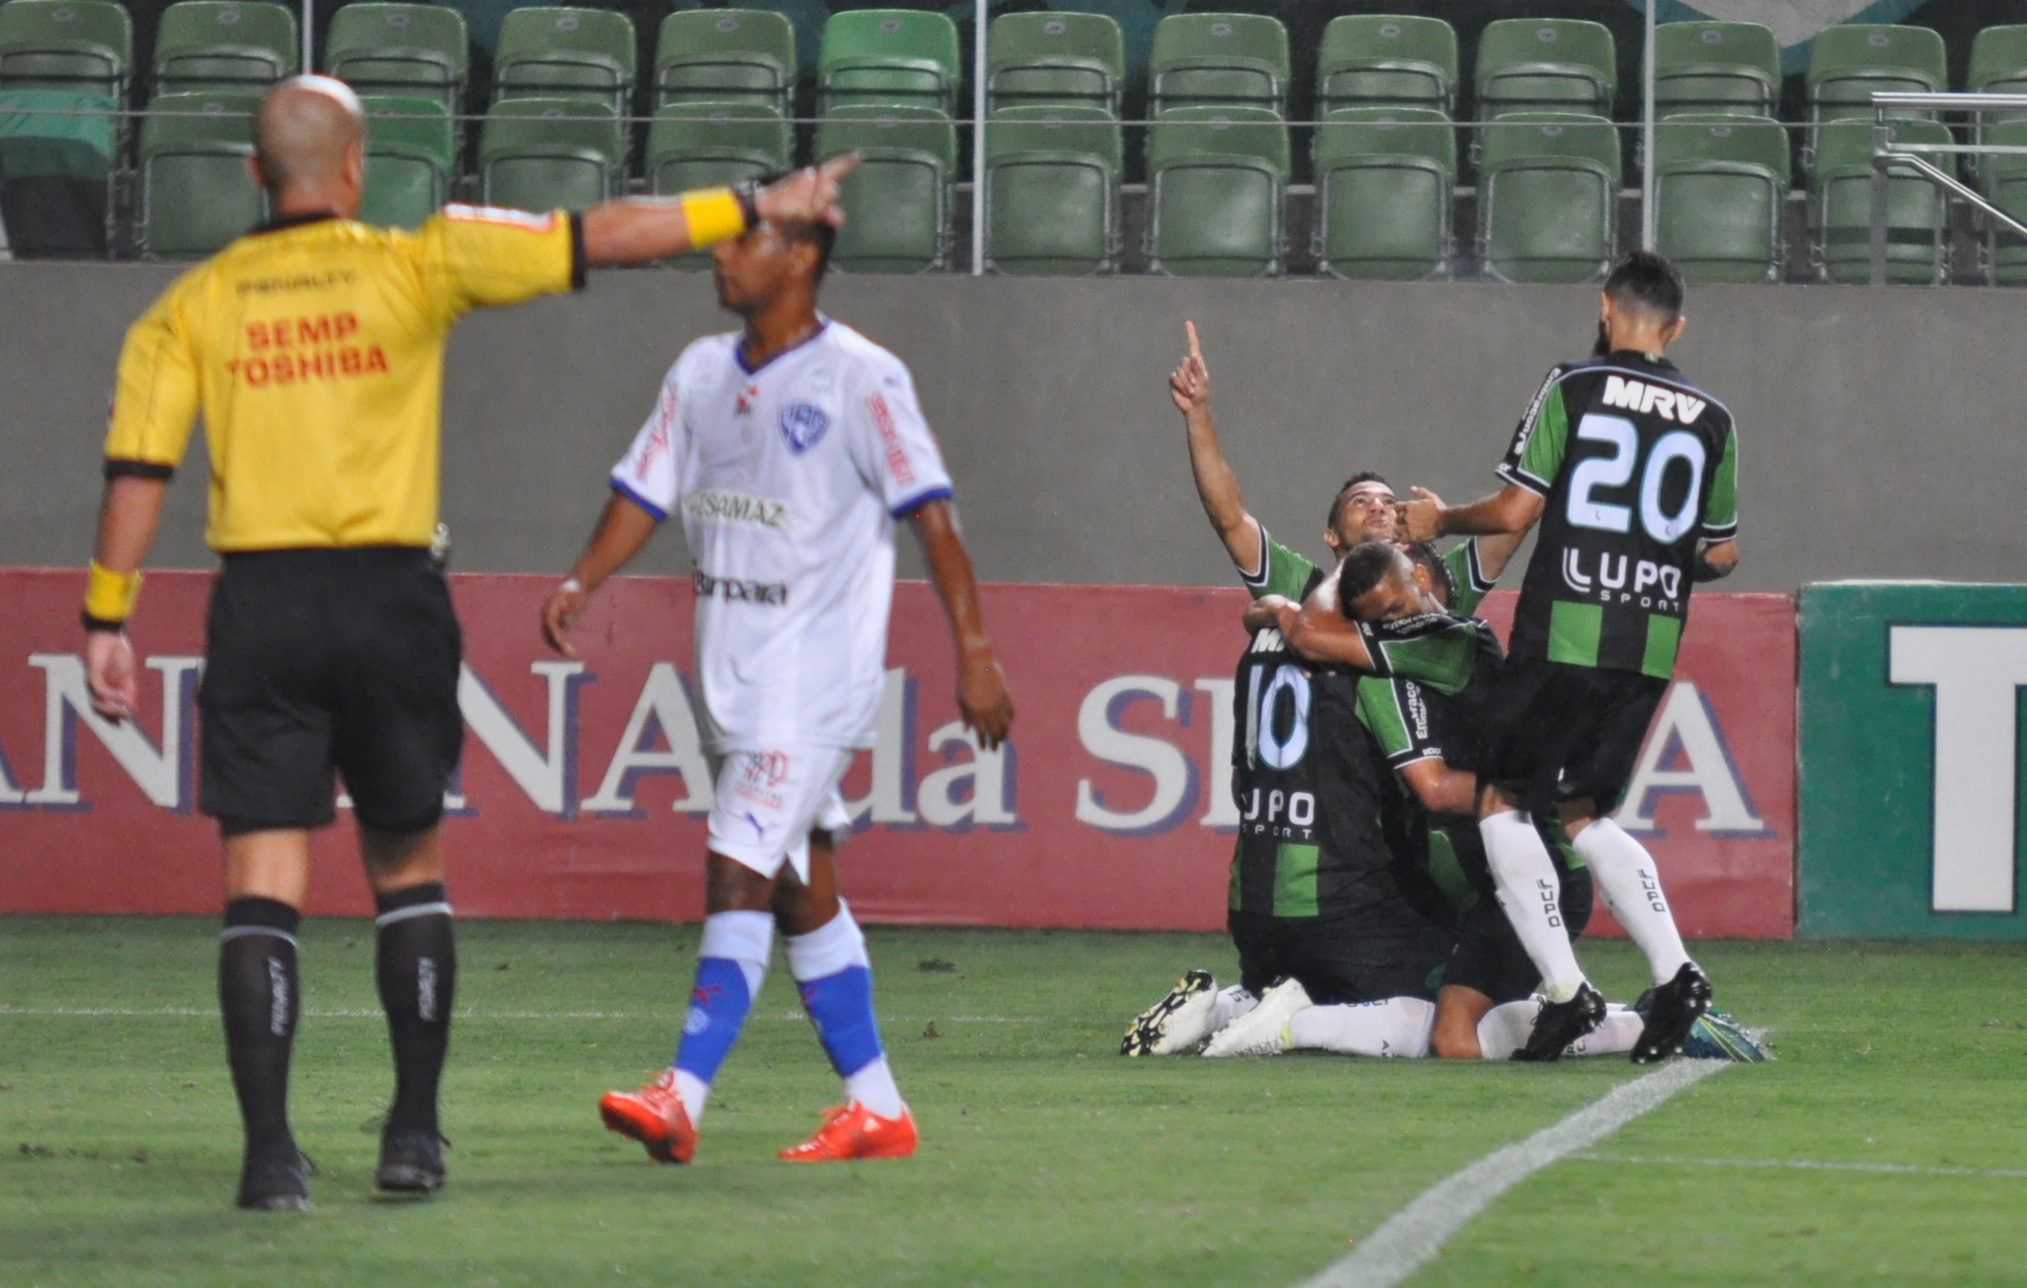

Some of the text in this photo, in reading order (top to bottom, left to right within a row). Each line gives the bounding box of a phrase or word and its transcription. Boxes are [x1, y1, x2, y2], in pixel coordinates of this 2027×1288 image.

[246, 311, 359, 351] SEMP
[225, 343, 388, 387] TOSHIBA
[1602, 375, 1706, 424] MRV
[1566, 412, 1706, 544] 20
[1563, 547, 1682, 599] LUPO
[1600, 589, 1681, 613] SPORT
[1246, 664, 1312, 770] 10
[1242, 788, 1316, 827] UPO
[1537, 878, 1562, 928] LUPO
[1638, 868, 1666, 913] LUPO
